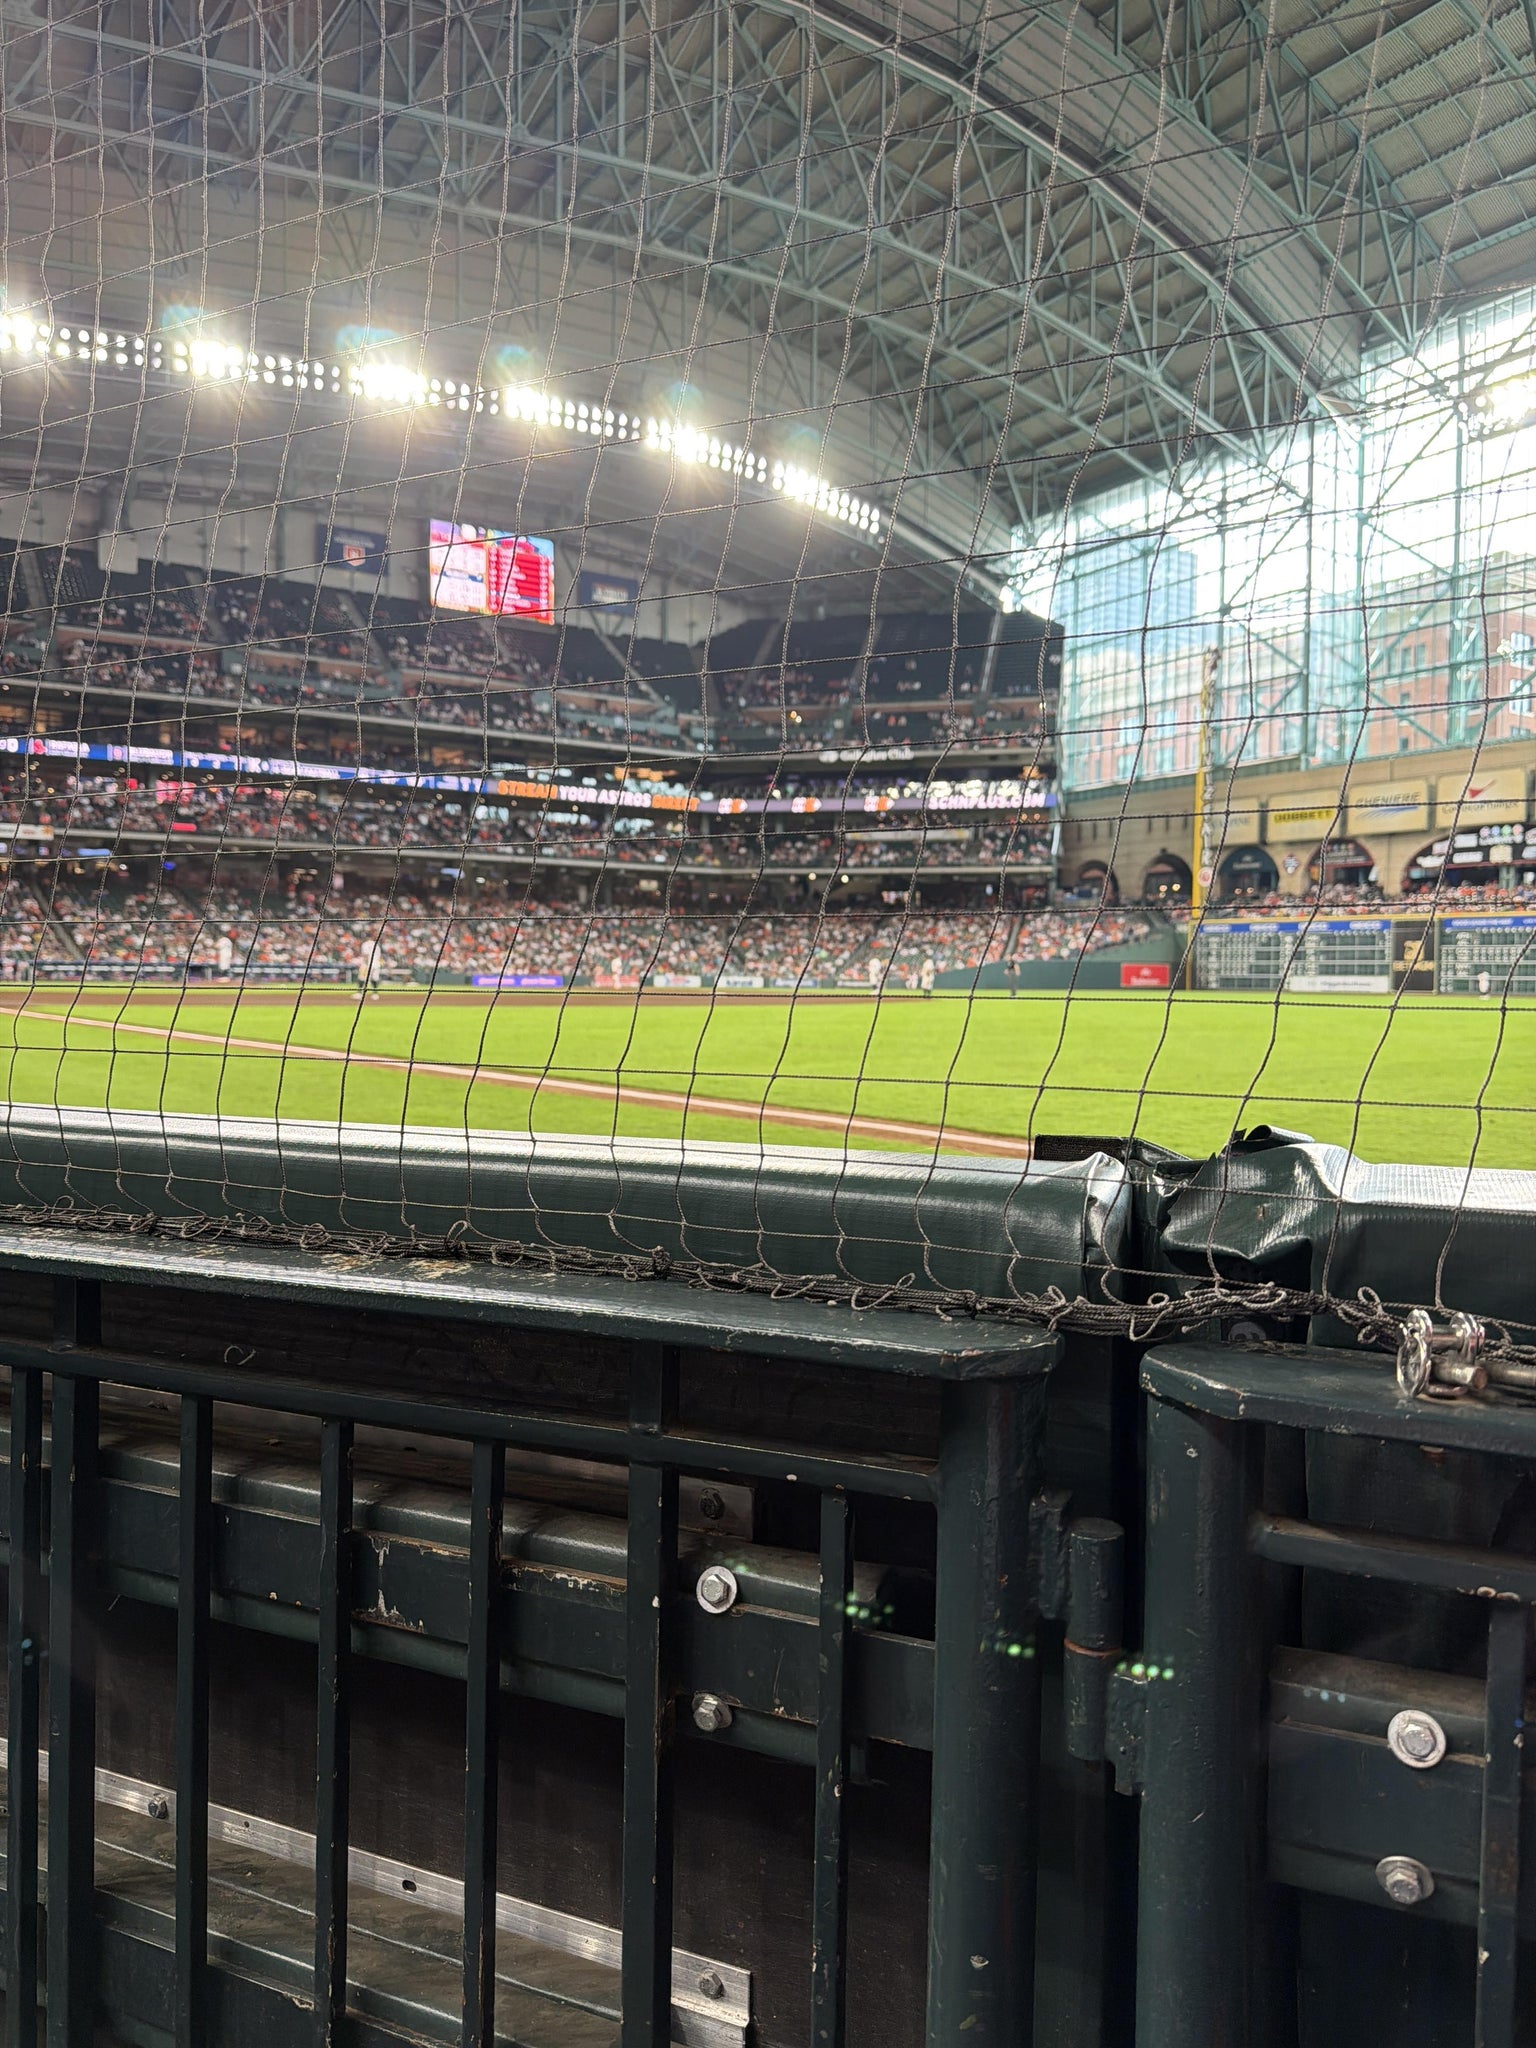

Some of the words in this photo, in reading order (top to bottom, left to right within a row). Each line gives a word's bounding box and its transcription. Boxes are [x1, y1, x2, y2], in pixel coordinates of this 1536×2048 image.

[497, 780, 558, 800] STREAM
[559, 785, 597, 803] YOUR
[597, 788, 651, 808] ASTROS
